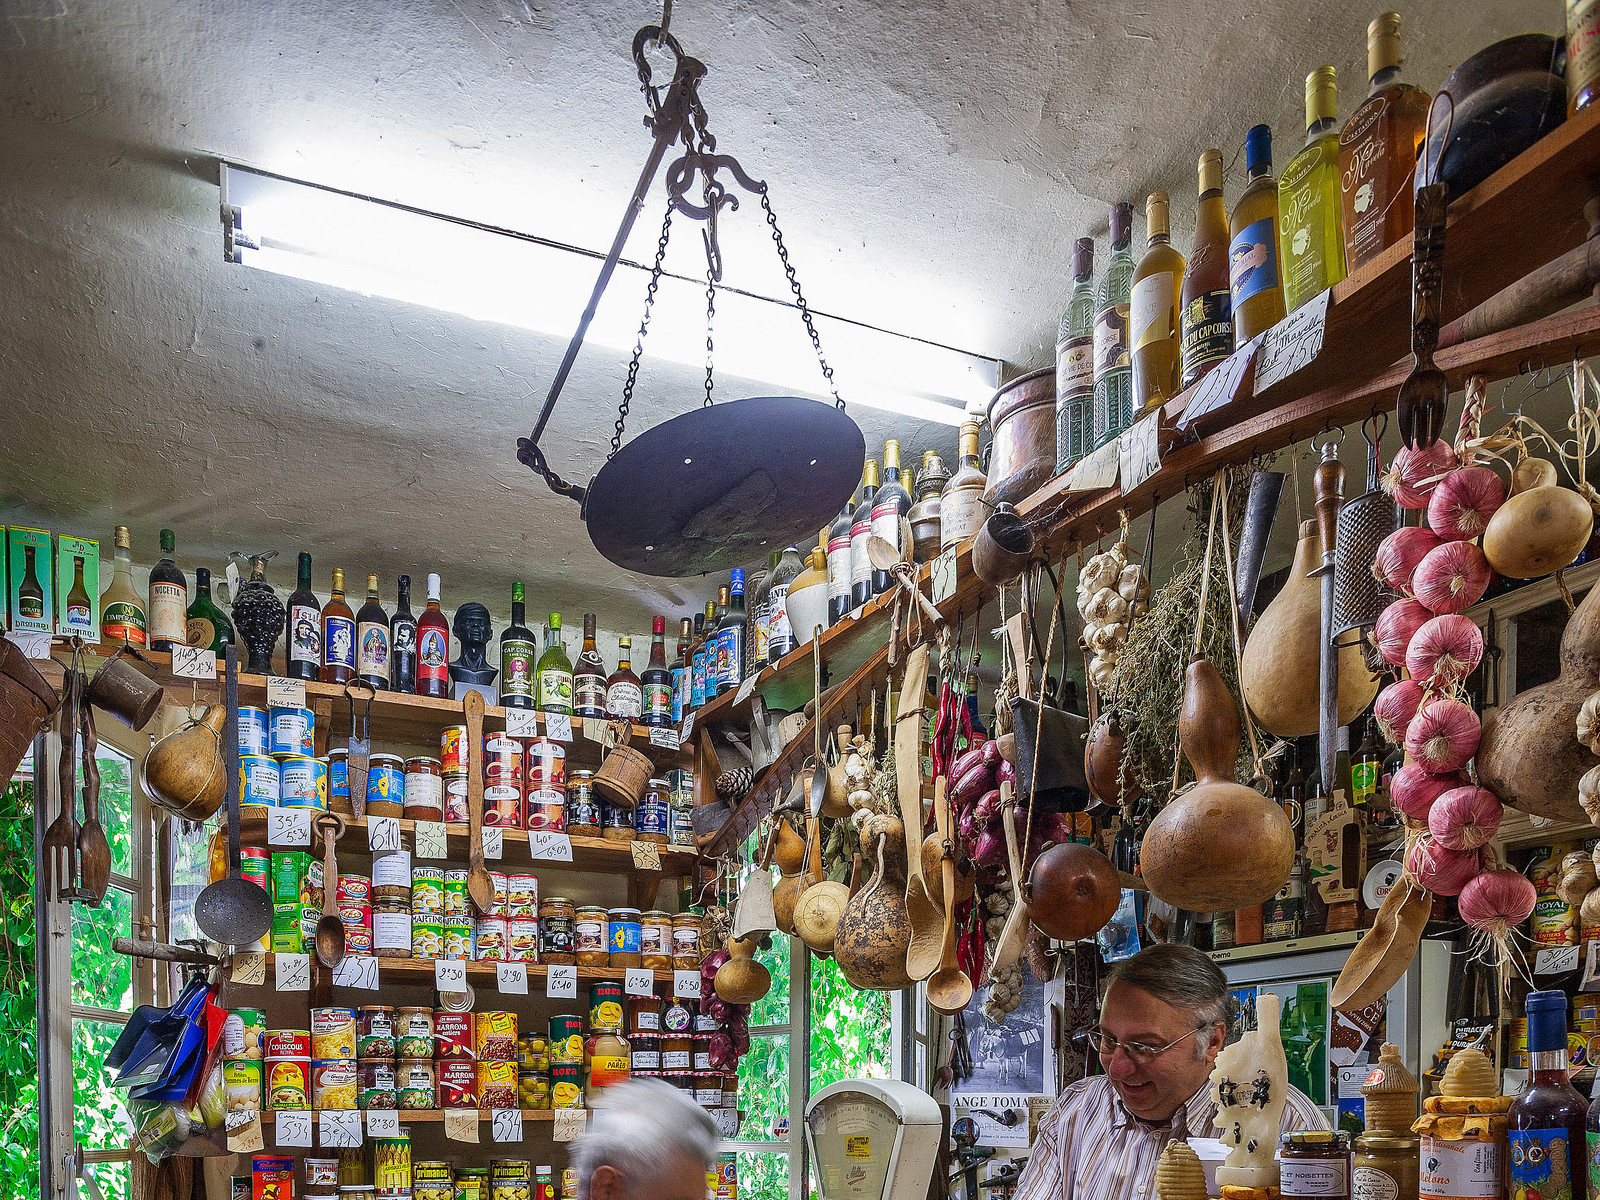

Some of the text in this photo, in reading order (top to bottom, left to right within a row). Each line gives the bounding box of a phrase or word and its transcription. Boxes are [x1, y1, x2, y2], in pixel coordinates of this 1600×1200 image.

[154, 586, 181, 597] NOCETTA
[491, 785, 509, 795] Tripes
[539, 789, 557, 799] Tripes
[412, 868, 444, 878] MARTINS
[1536, 902, 1566, 912] ROYAL
[412, 914, 444, 923] MARTINS
[597, 986, 621, 996] nora
[437, 1023, 468, 1032] MARRONS
[271, 1043, 303, 1051] COUSCOUS
[444, 1071, 475, 1081] MARRONS
[552, 1066, 577, 1076] nora
[953, 1096, 1028, 1108] ANGE TOMA
[416, 1168, 448, 1179] primance
[493, 1167, 524, 1178] primance
